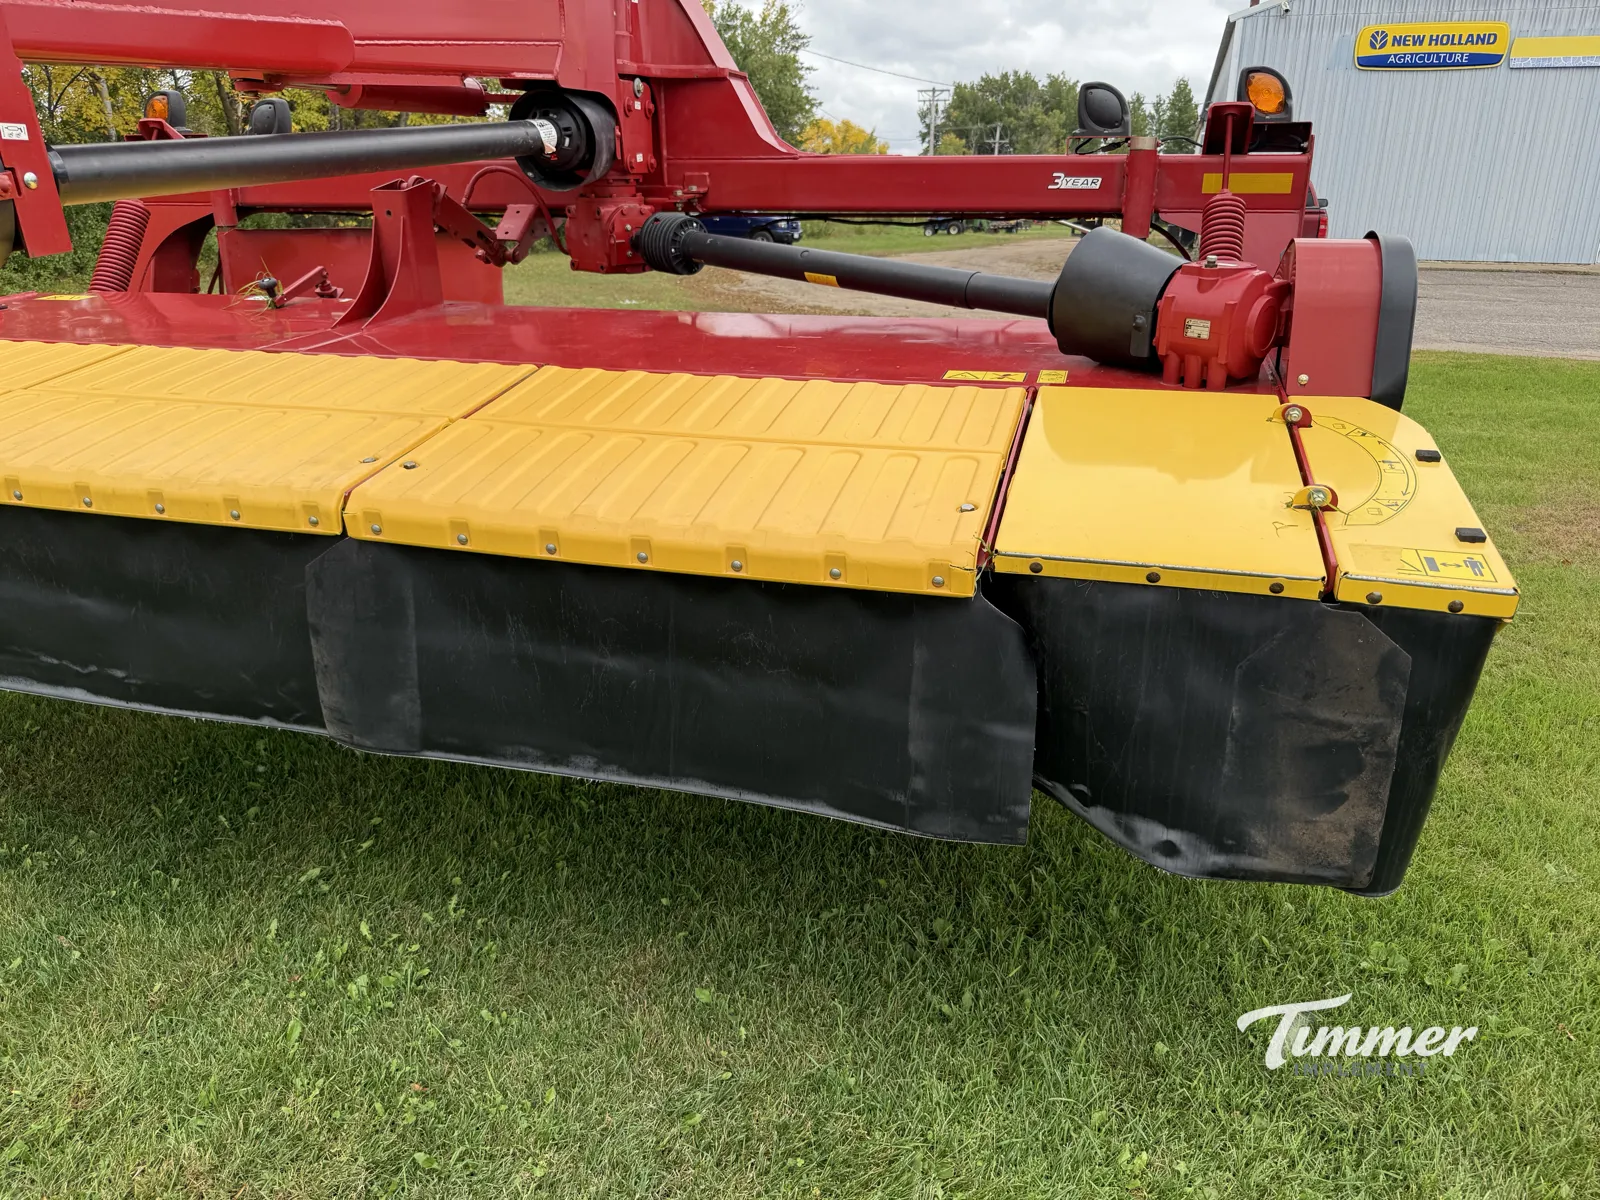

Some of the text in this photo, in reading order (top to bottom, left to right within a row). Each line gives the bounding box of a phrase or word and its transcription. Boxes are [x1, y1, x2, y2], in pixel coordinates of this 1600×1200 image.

[1391, 32, 1498, 47] NEW HOLLAND
[1387, 53, 1469, 64] AGRICULTURE
[1047, 172, 1100, 189] 3 YEAR
